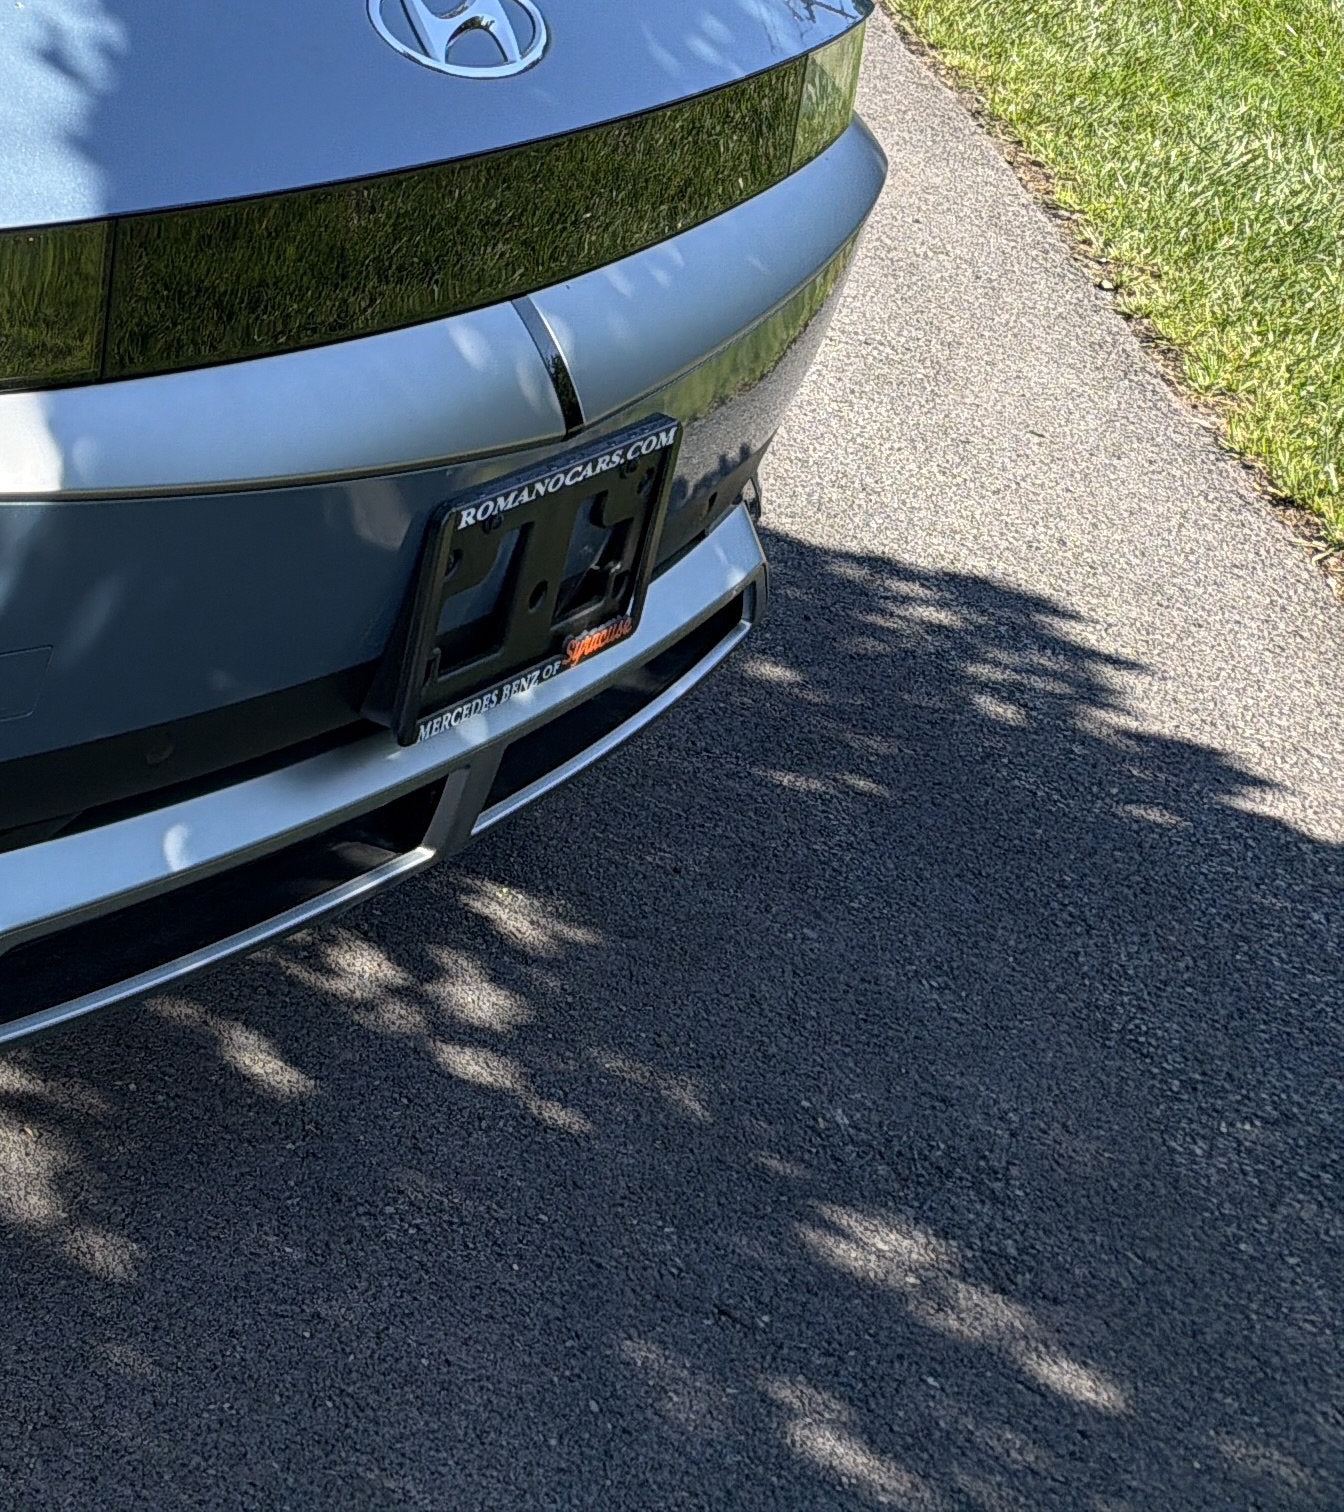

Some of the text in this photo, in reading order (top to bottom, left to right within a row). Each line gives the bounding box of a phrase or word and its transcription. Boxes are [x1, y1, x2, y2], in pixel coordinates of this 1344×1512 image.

[457, 426, 678, 530] ROMANOCARS.COM
[416, 616, 633, 744] MERCEDES BENZ OF Syracuse
